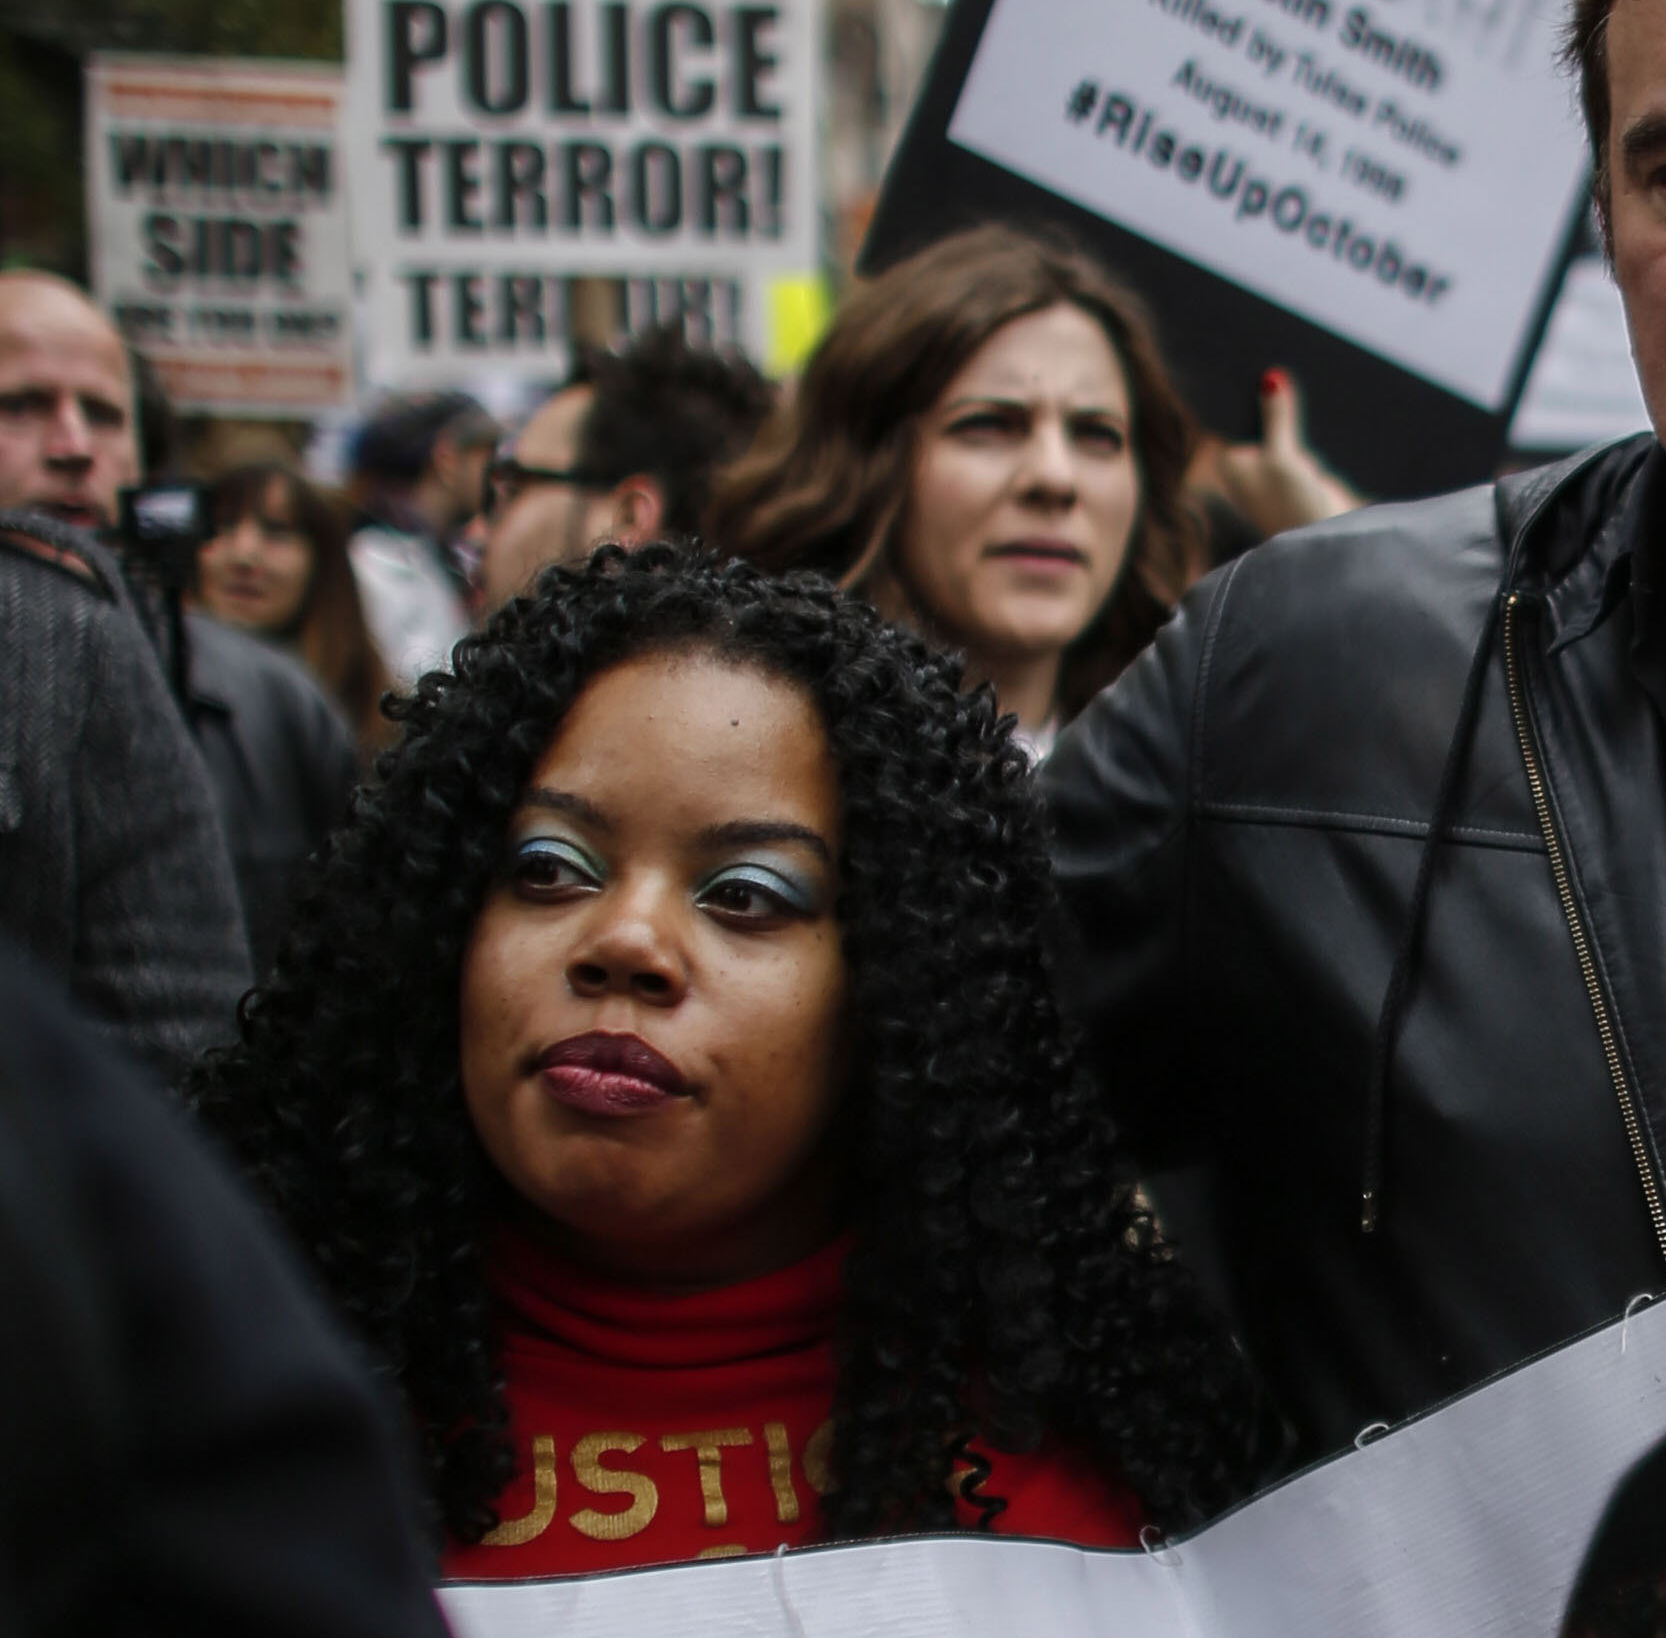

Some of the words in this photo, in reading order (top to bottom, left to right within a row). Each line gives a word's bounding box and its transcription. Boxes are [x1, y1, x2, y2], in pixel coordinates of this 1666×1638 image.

[1340, 5, 1445, 92] Smith
[1171, 58, 1285, 140] August
[1247, 28, 1286, 76] by
[1295, 51, 1368, 118] Tulsa
[1374, 98, 1462, 166] Police
[108, 130, 332, 197] WHICH
[380, 136, 785, 243] TERROR!
[1066, 76, 1451, 305] #RiseUpOctober
[142, 212, 304, 284] SIDE
